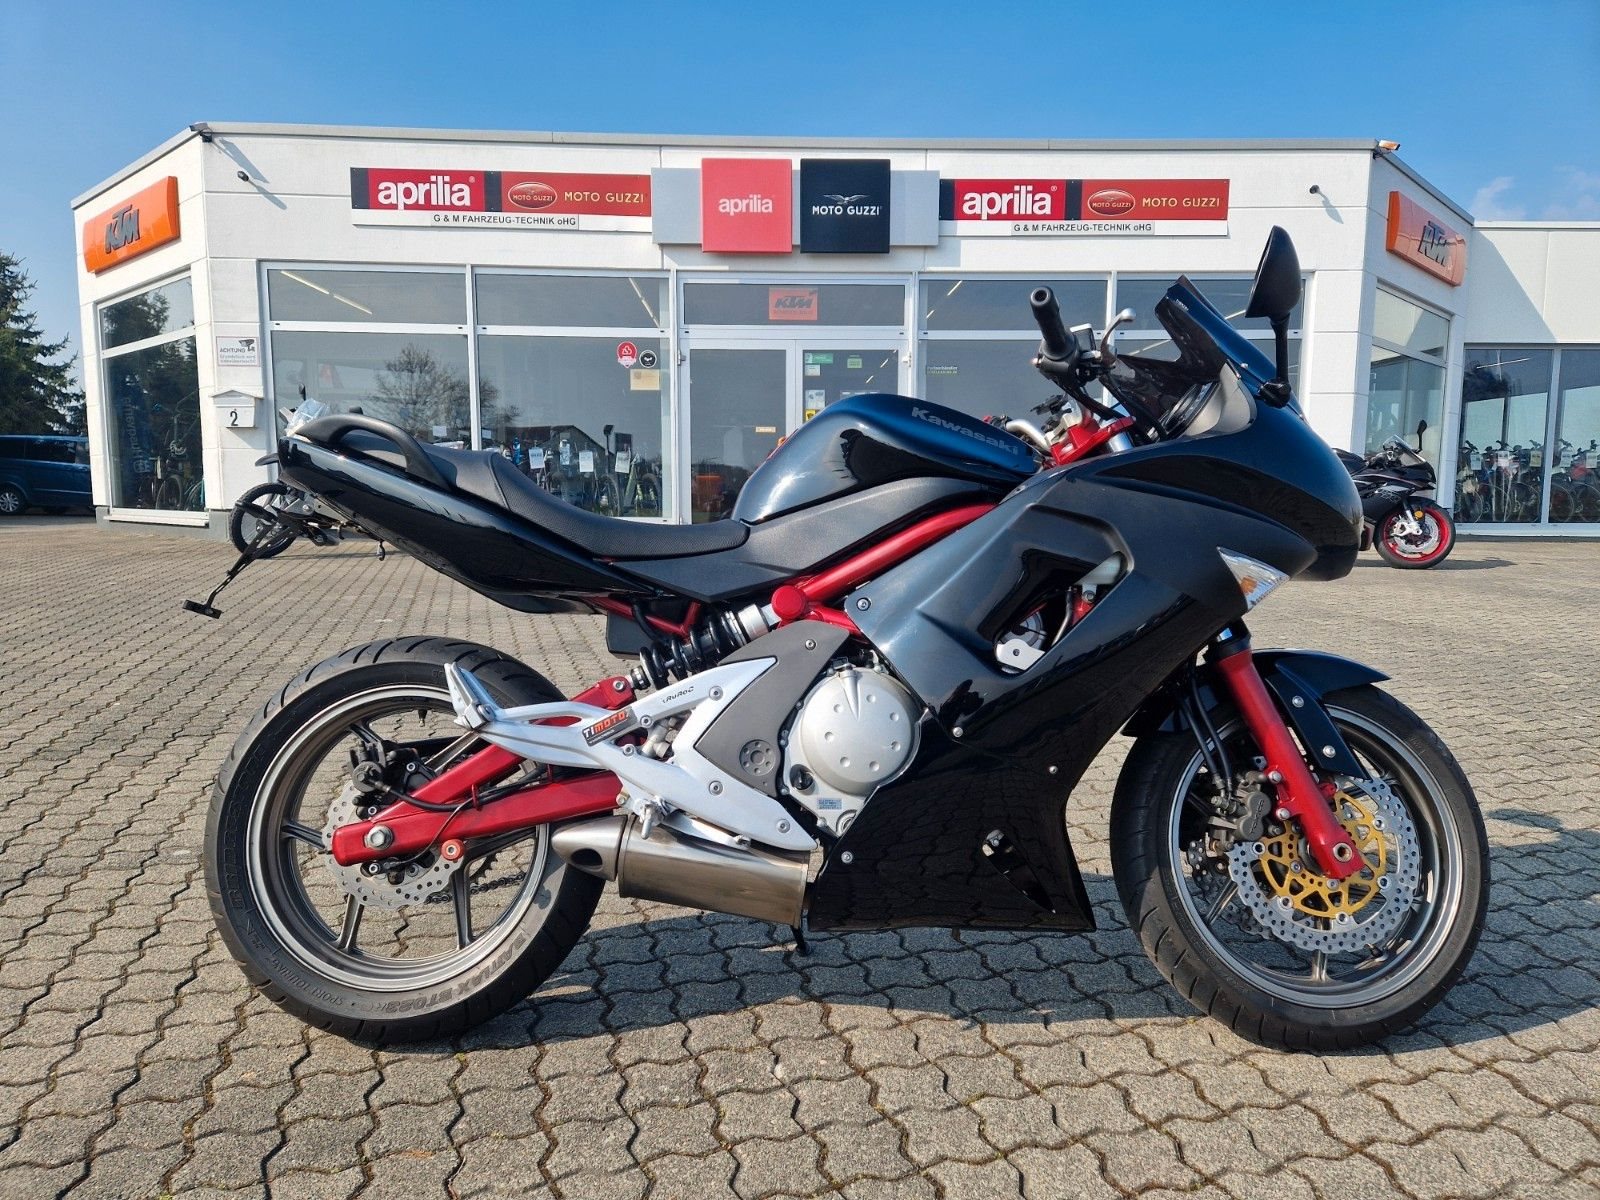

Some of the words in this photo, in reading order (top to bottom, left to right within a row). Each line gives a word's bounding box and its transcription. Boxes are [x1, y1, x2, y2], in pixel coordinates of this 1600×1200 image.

[377, 175, 471, 210] aprilia
[564, 191, 601, 202] MOTO
[605, 192, 644, 204] GUZZI
[718, 194, 773, 216] aprilia
[812, 205, 843, 216] MOTO
[846, 206, 880, 216] GUZZI
[962, 185, 1052, 220] aprilia
[1142, 197, 1178, 208] MOTO
[1182, 197, 1220, 208] GUZZI
[433, 214, 441, 222] G
[452, 215, 460, 223] M
[462, 215, 555, 225] FAHRZEUG-TECHNIK
[557, 217, 576, 226] oHG
[1013, 224, 1021, 232] G
[1023, 224, 1030, 232] &
[1032, 224, 1039, 232] M
[1041, 224, 1131, 232] FAHRZEUG-TECHNIK
[1133, 224, 1152, 232] oHG
[105, 204, 140, 254] KTM
[1418, 221, 1451, 267] KTM
[774, 295, 813, 309] KTM
[229, 410, 239, 427] 2
[911, 406, 1019, 456] Kawasaki
